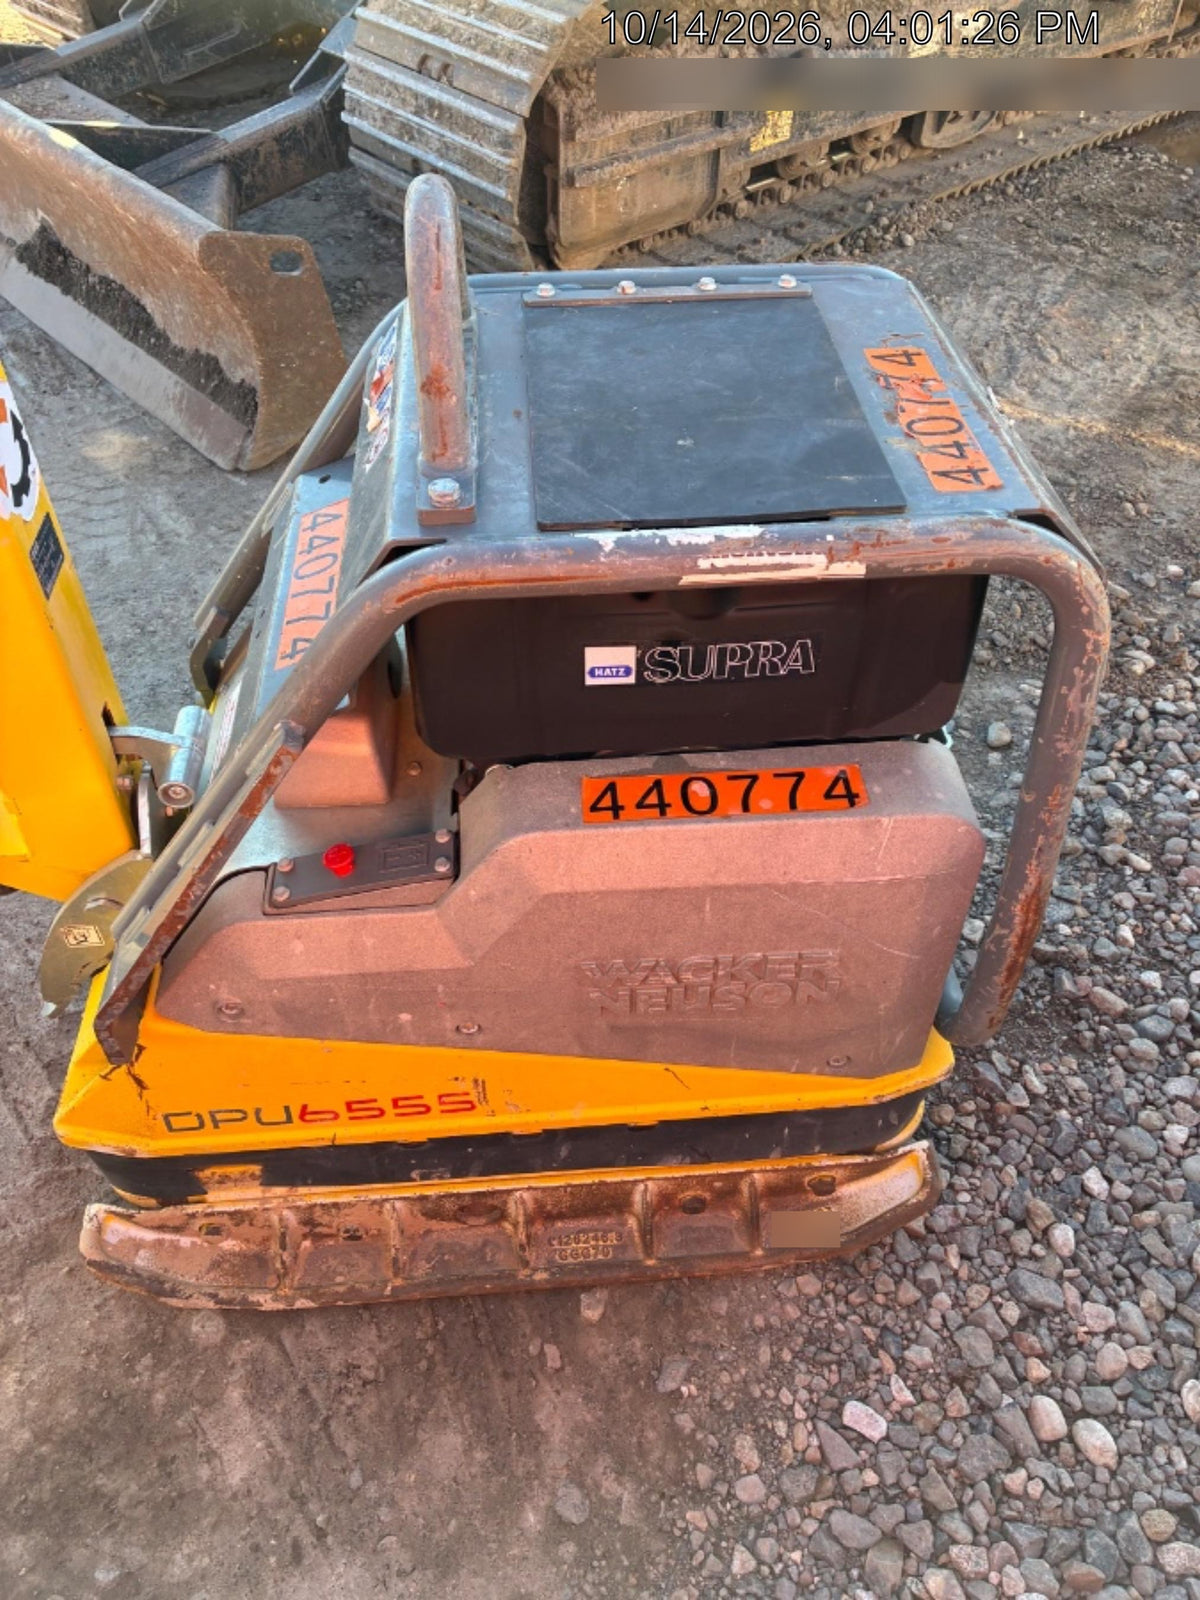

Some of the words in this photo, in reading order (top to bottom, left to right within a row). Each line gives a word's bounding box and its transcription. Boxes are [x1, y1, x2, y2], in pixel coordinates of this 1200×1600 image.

[279, 513, 342, 660] 440774
[594, 667, 627, 677] HATZ
[643, 639, 816, 683] SUPRA
[589, 769, 860, 820] 440774
[581, 950, 841, 988] WACKER
[589, 981, 840, 1015] NEUSON
